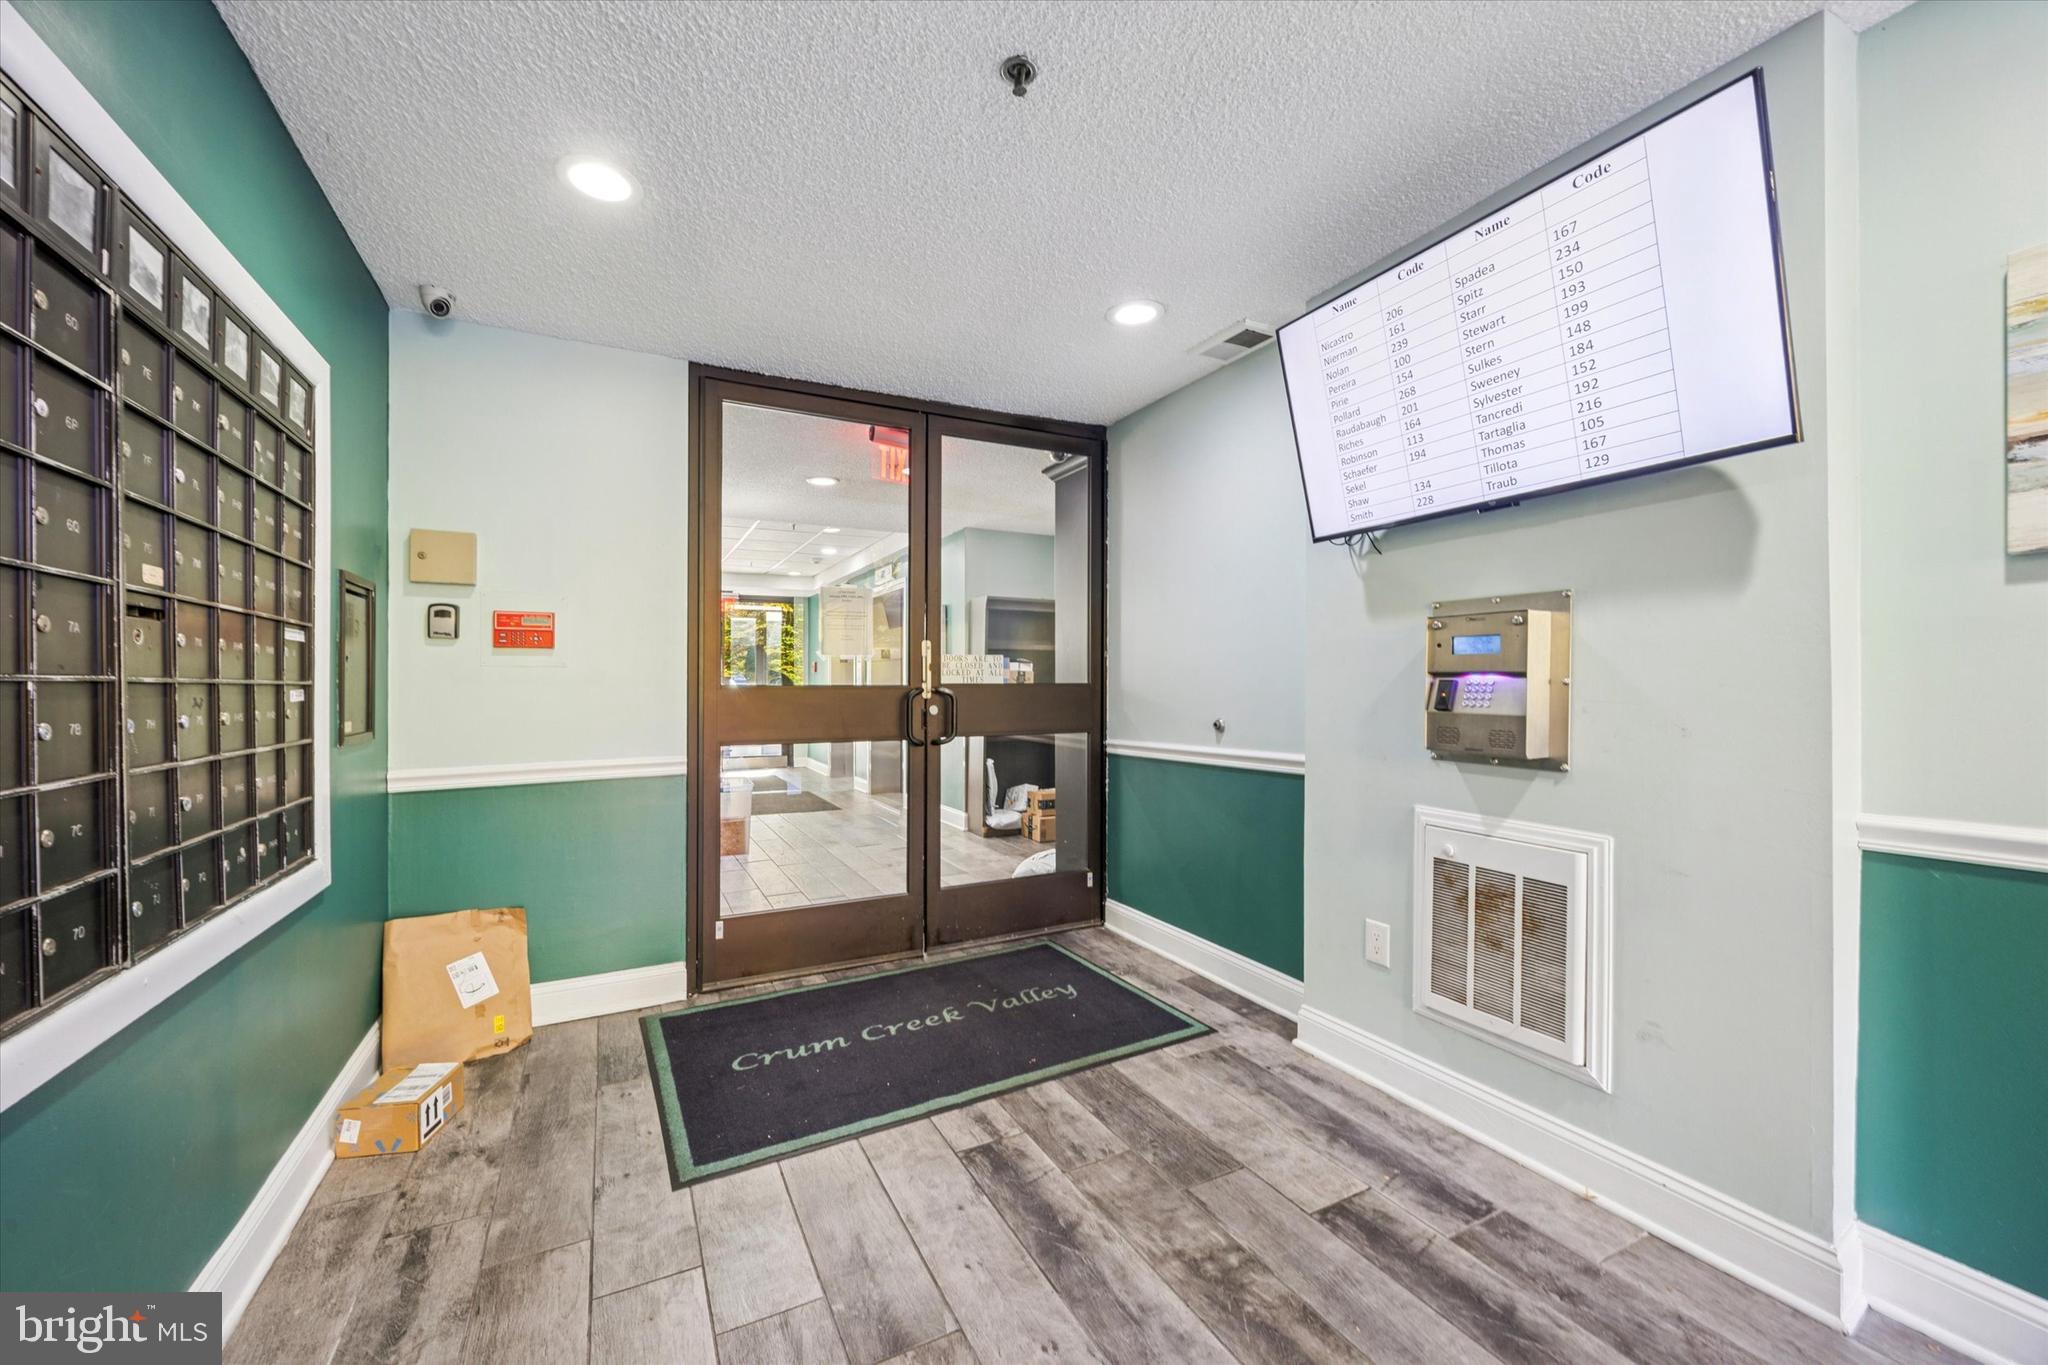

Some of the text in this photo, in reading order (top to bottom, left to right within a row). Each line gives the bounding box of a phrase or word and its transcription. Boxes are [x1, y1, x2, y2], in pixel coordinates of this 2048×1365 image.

[1332, 162, 1612, 315] Name Code Name Code
[1321, 220, 1577, 352] Nicastro 206 Spadea 167
[1323, 241, 1580, 366] Nierman 161 Spitz 234
[1326, 260, 1584, 381] Nolan 239 Starr 150
[1328, 280, 1586, 396] Pereira 100 Stewart 193
[1334, 320, 1592, 424] Pollard 268 Sulkes 148
[1396, 370, 1413, 384] 154
[1465, 338, 1495, 357] Stern
[1564, 300, 1589, 319] 199
[1336, 339, 1594, 438] Raudabaugh 201 Sweeney 184
[1338, 358, 1597, 452] Riches 164 Sylvester 152
[1341, 378, 1600, 466] Robinson 113 Tancredi 192
[1344, 396, 1602, 481] Schaefer 194 Tartaglia 216
[1346, 416, 1605, 494] Sekel Thomas 105
[1348, 435, 1607, 508] Shaw 134 Tillota 167
[1350, 454, 1610, 522] Smith 228 Traub 129
[67, 620, 80, 633] 7A
[69, 723, 82, 736] 7B
[70, 824, 83, 837] 7C
[731, 983, 1078, 1072] Crum Creek Valley
